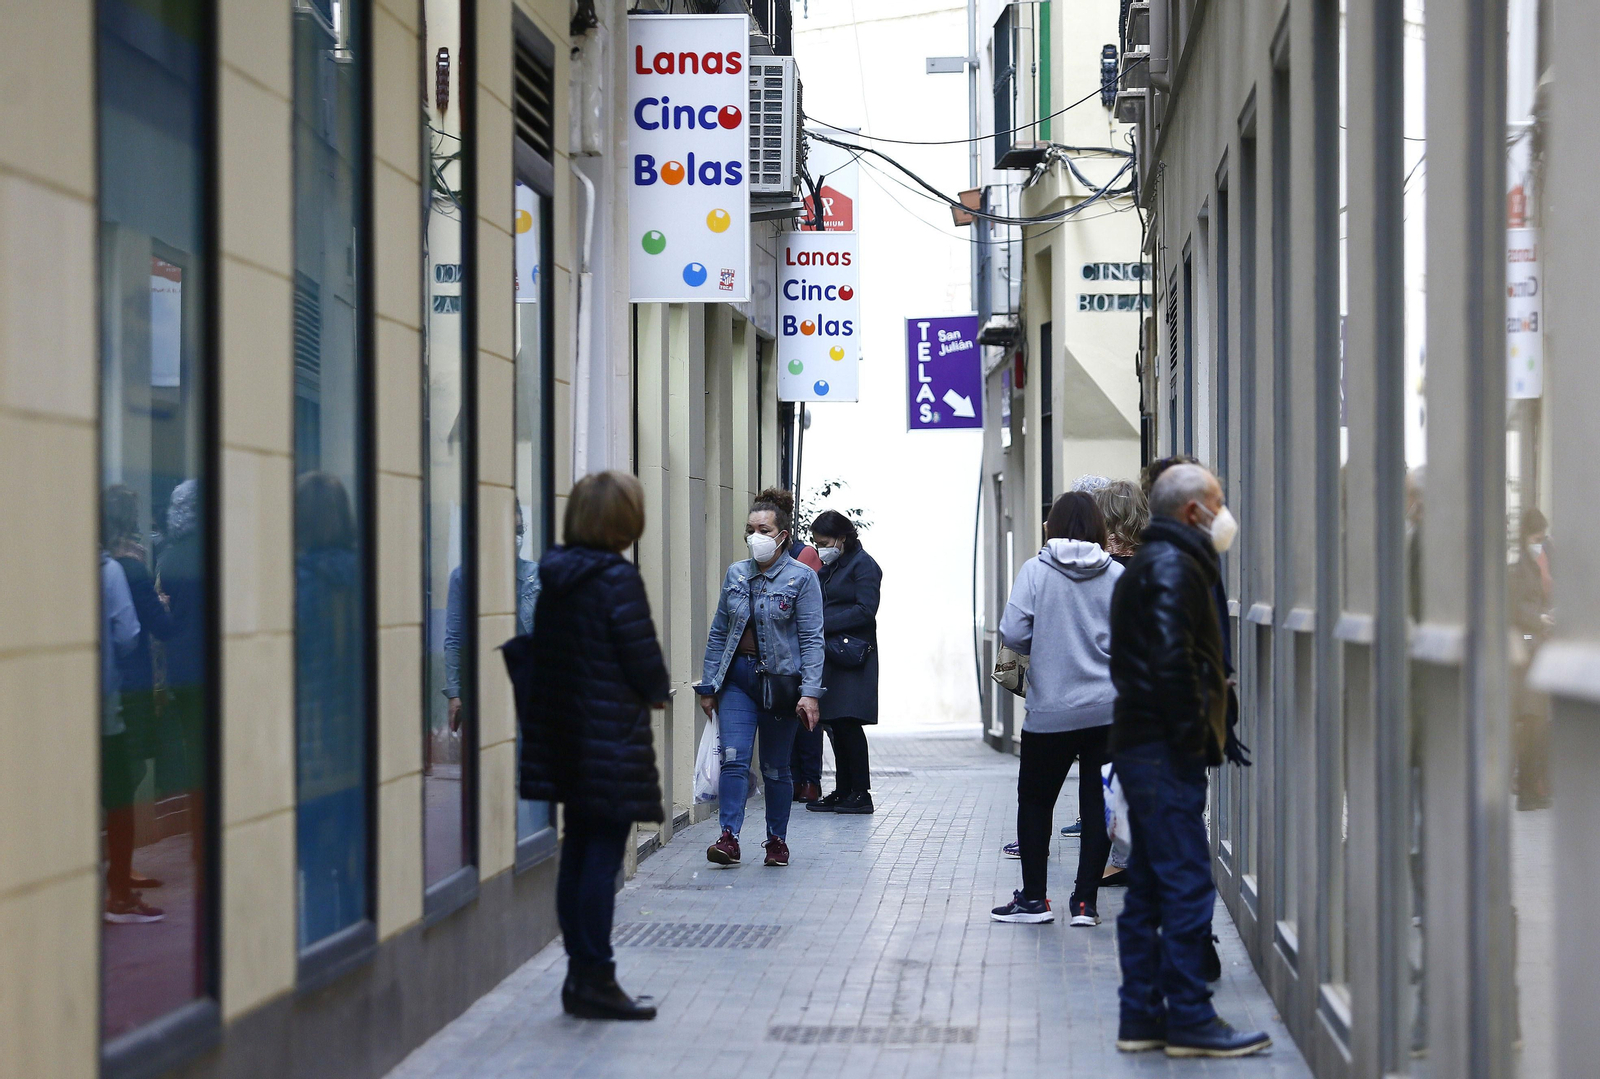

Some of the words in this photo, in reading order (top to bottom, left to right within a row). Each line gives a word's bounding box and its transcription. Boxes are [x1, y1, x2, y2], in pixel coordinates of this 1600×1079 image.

[635, 45, 742, 74] Lanas
[634, 96, 742, 130] Cinco
[634, 152, 742, 186] Bolas
[785, 247, 852, 266] Lanas
[783, 279, 853, 301] Cinco
[1077, 294, 1152, 312] BOLA
[783, 315, 853, 337] Bolas
[938, 329, 961, 342] San
[939, 340, 973, 357] Julián
[916, 321, 936, 423] TELAS
